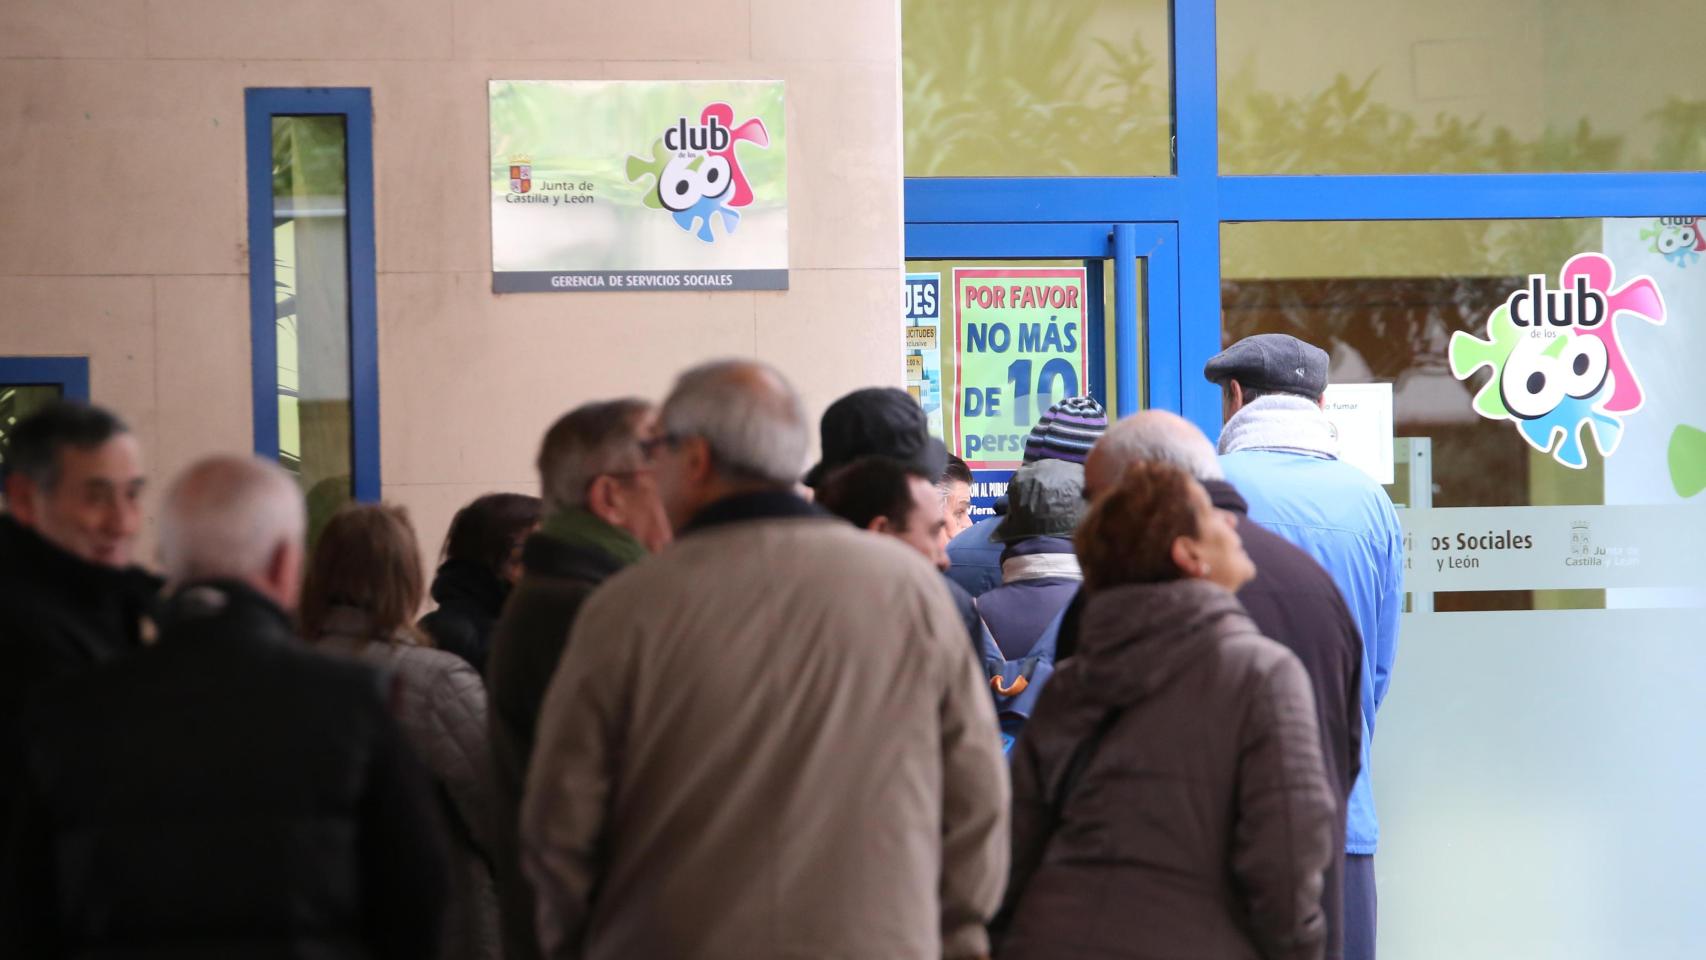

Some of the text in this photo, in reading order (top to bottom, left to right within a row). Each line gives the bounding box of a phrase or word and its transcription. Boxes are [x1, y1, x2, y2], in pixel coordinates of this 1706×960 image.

[664, 117, 730, 151] club
[539, 180, 594, 192] Junta de
[505, 192, 595, 207] Castilla y León
[551, 274, 733, 288] GERENCIA DE SERVICIOS SOCIALES
[965, 285, 1079, 309] POR FAVOR
[1510, 277, 1604, 328] club
[967, 315, 1078, 353] NO MÁS
[1530, 329, 1557, 339] de los
[964, 358, 1079, 427] DE 10
[1332, 402, 1358, 410] fumar
[1457, 530, 1533, 550] Sociales
[1436, 556, 1480, 572] y León
[1565, 557, 1603, 567] Castilla
